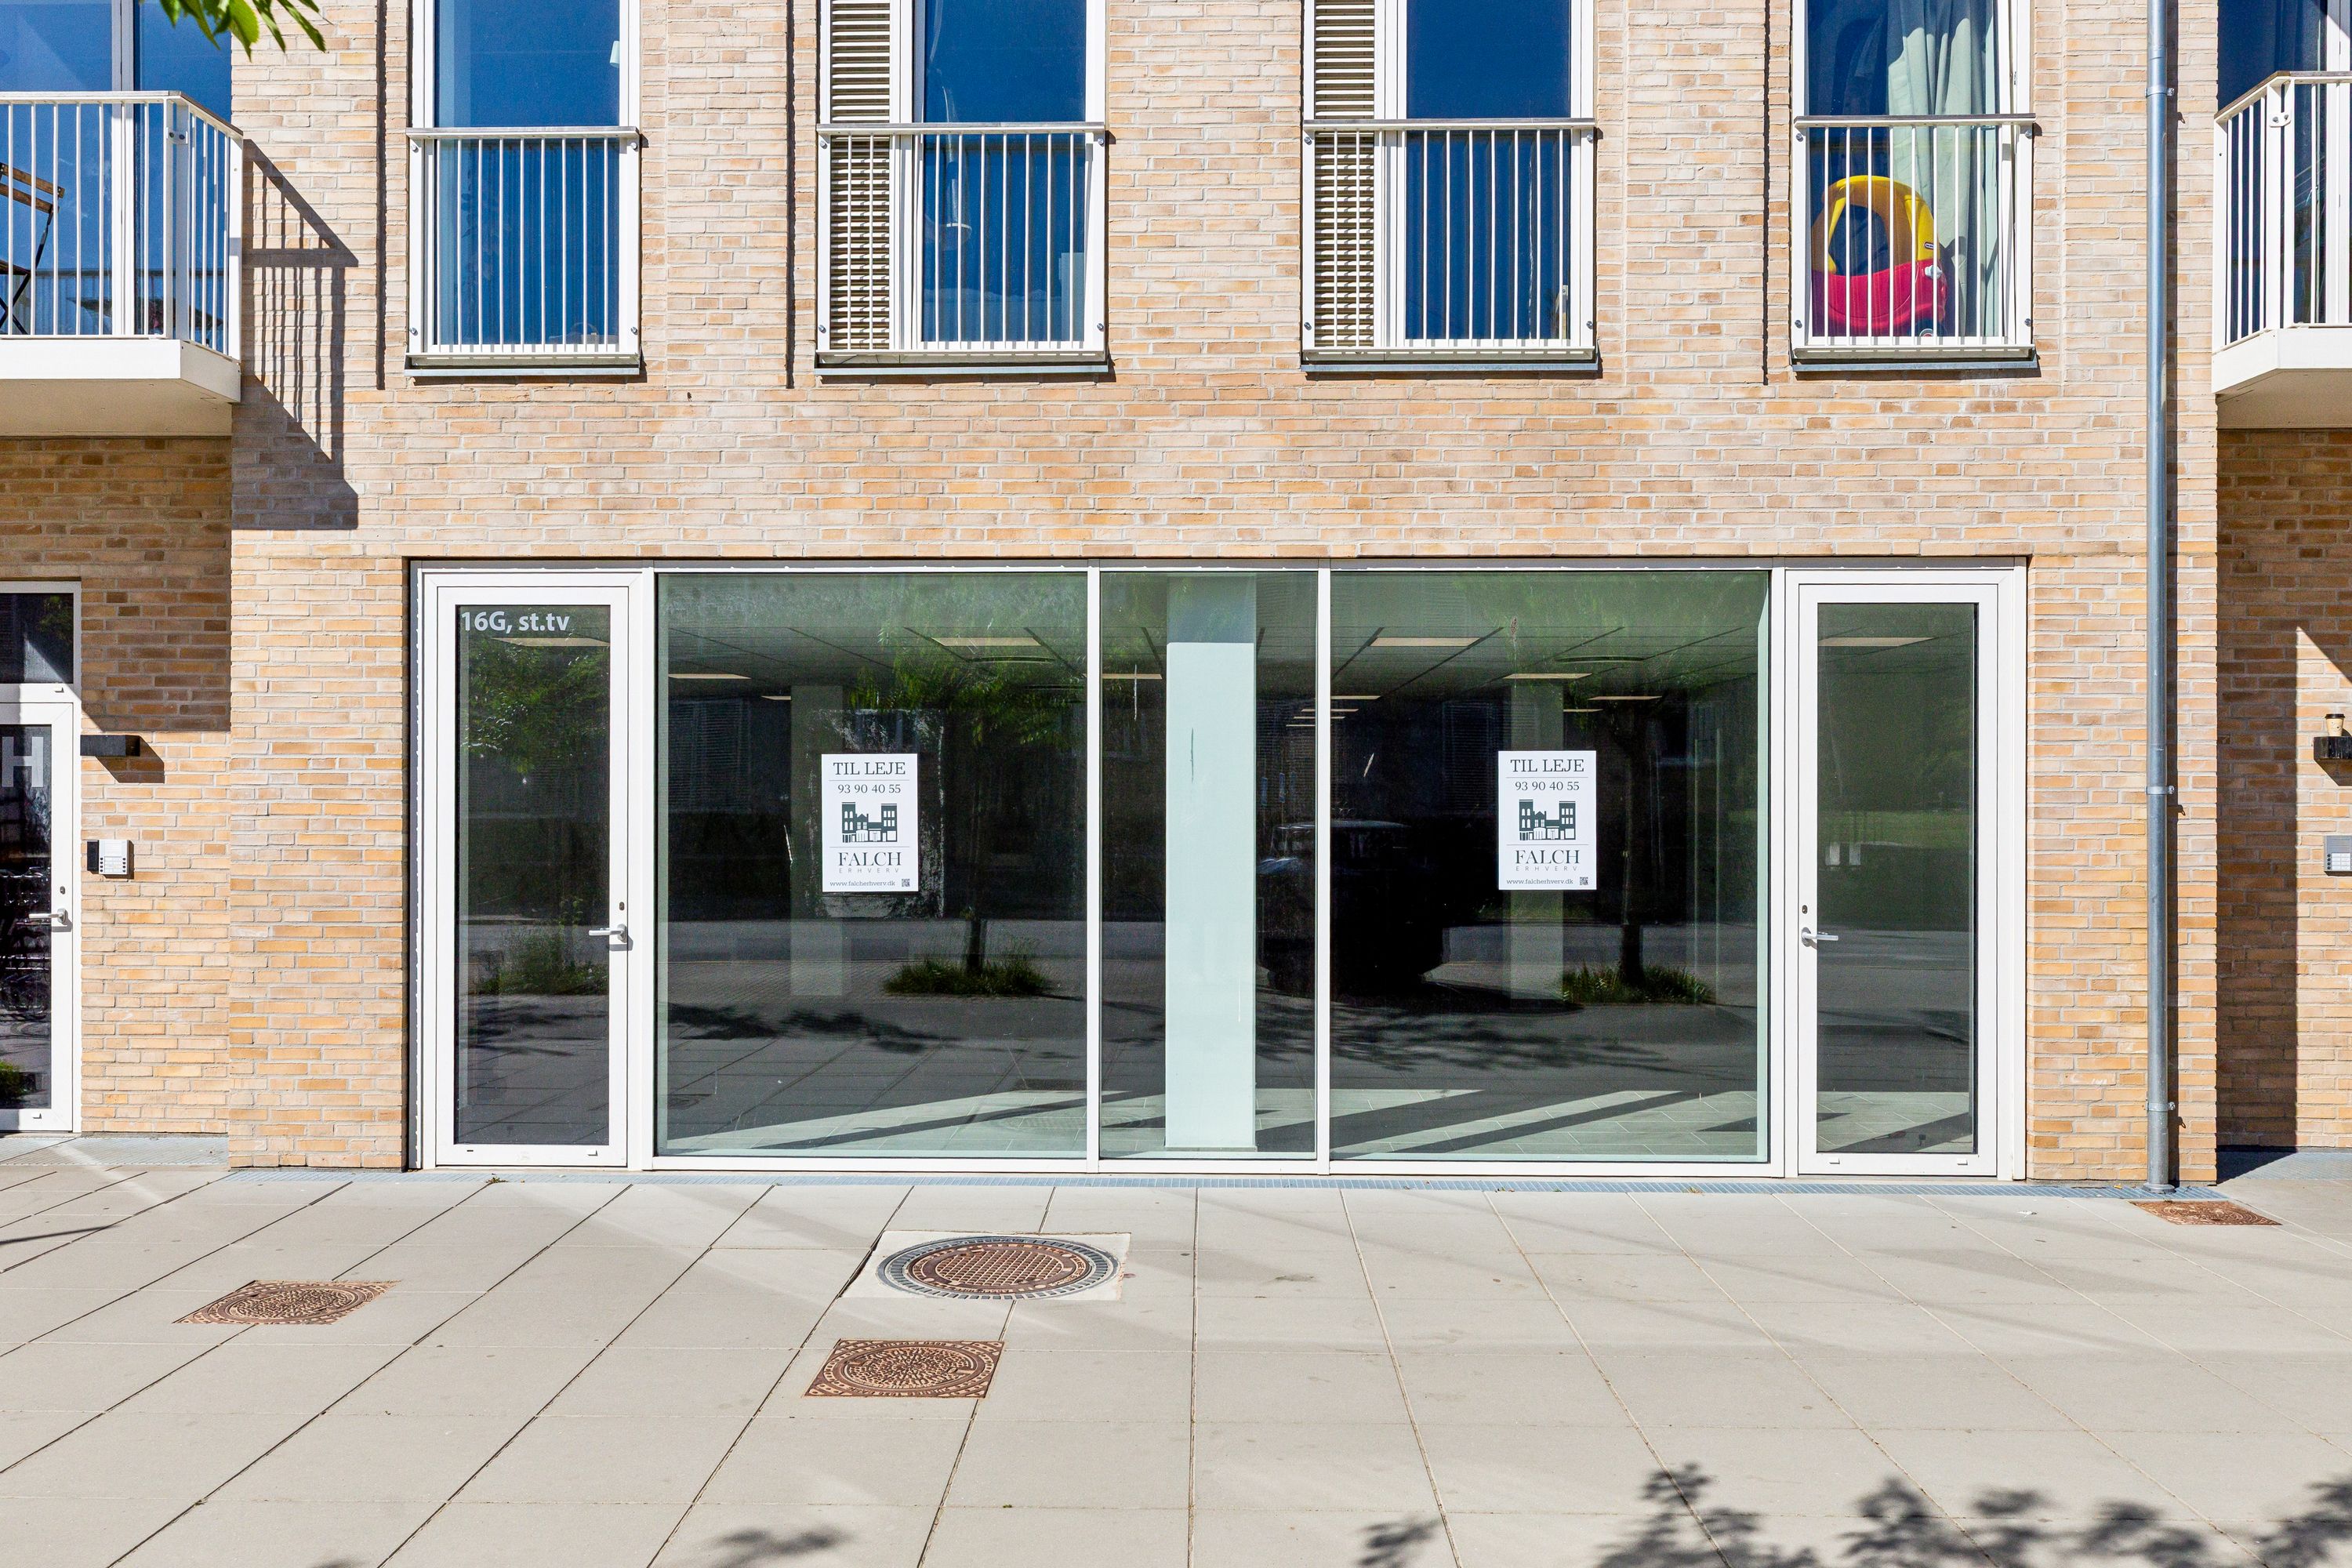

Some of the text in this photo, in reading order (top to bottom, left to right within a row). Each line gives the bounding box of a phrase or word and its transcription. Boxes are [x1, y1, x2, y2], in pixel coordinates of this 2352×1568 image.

[461, 611, 570, 634] 16G, st.tv
[833, 762, 906, 775] TIL LEJE
[1511, 759, 1584, 771] TIL LEJE
[838, 785, 851, 793] 93
[855, 785, 868, 793] 90
[872, 784, 886, 793] 40
[1515, 782, 1580, 790] 93 90 40 55
[839, 852, 902, 866] FALCH
[1515, 850, 1580, 864] FALCH
